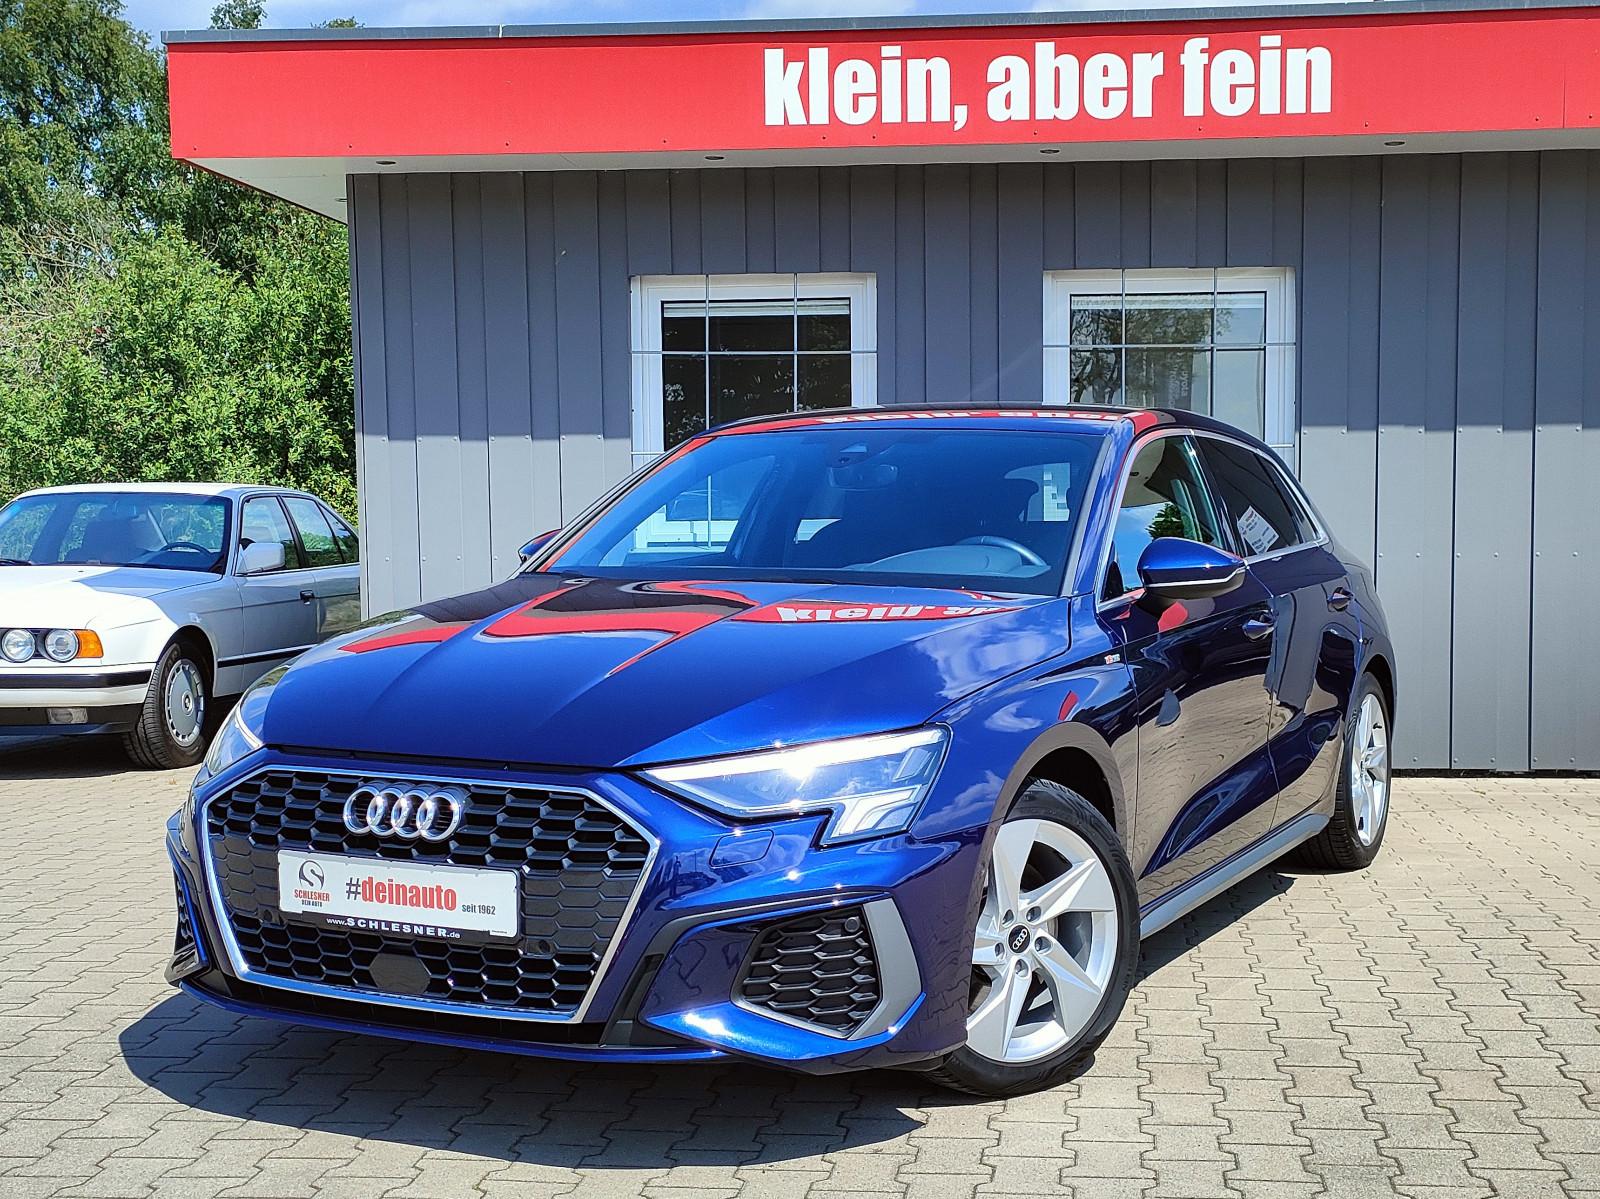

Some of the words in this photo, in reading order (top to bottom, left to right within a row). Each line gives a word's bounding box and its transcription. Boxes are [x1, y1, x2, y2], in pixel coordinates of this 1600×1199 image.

[764, 46, 968, 131] klein,
[986, 41, 1164, 121] aber
[1180, 35, 1332, 115] fein
[294, 889, 330, 902] SCHLESNER
[346, 876, 457, 911] #deinauto
[462, 904, 476, 913] seit
[478, 905, 496, 916] 1962
[326, 917, 460, 939] www.SCHLESNER.de
